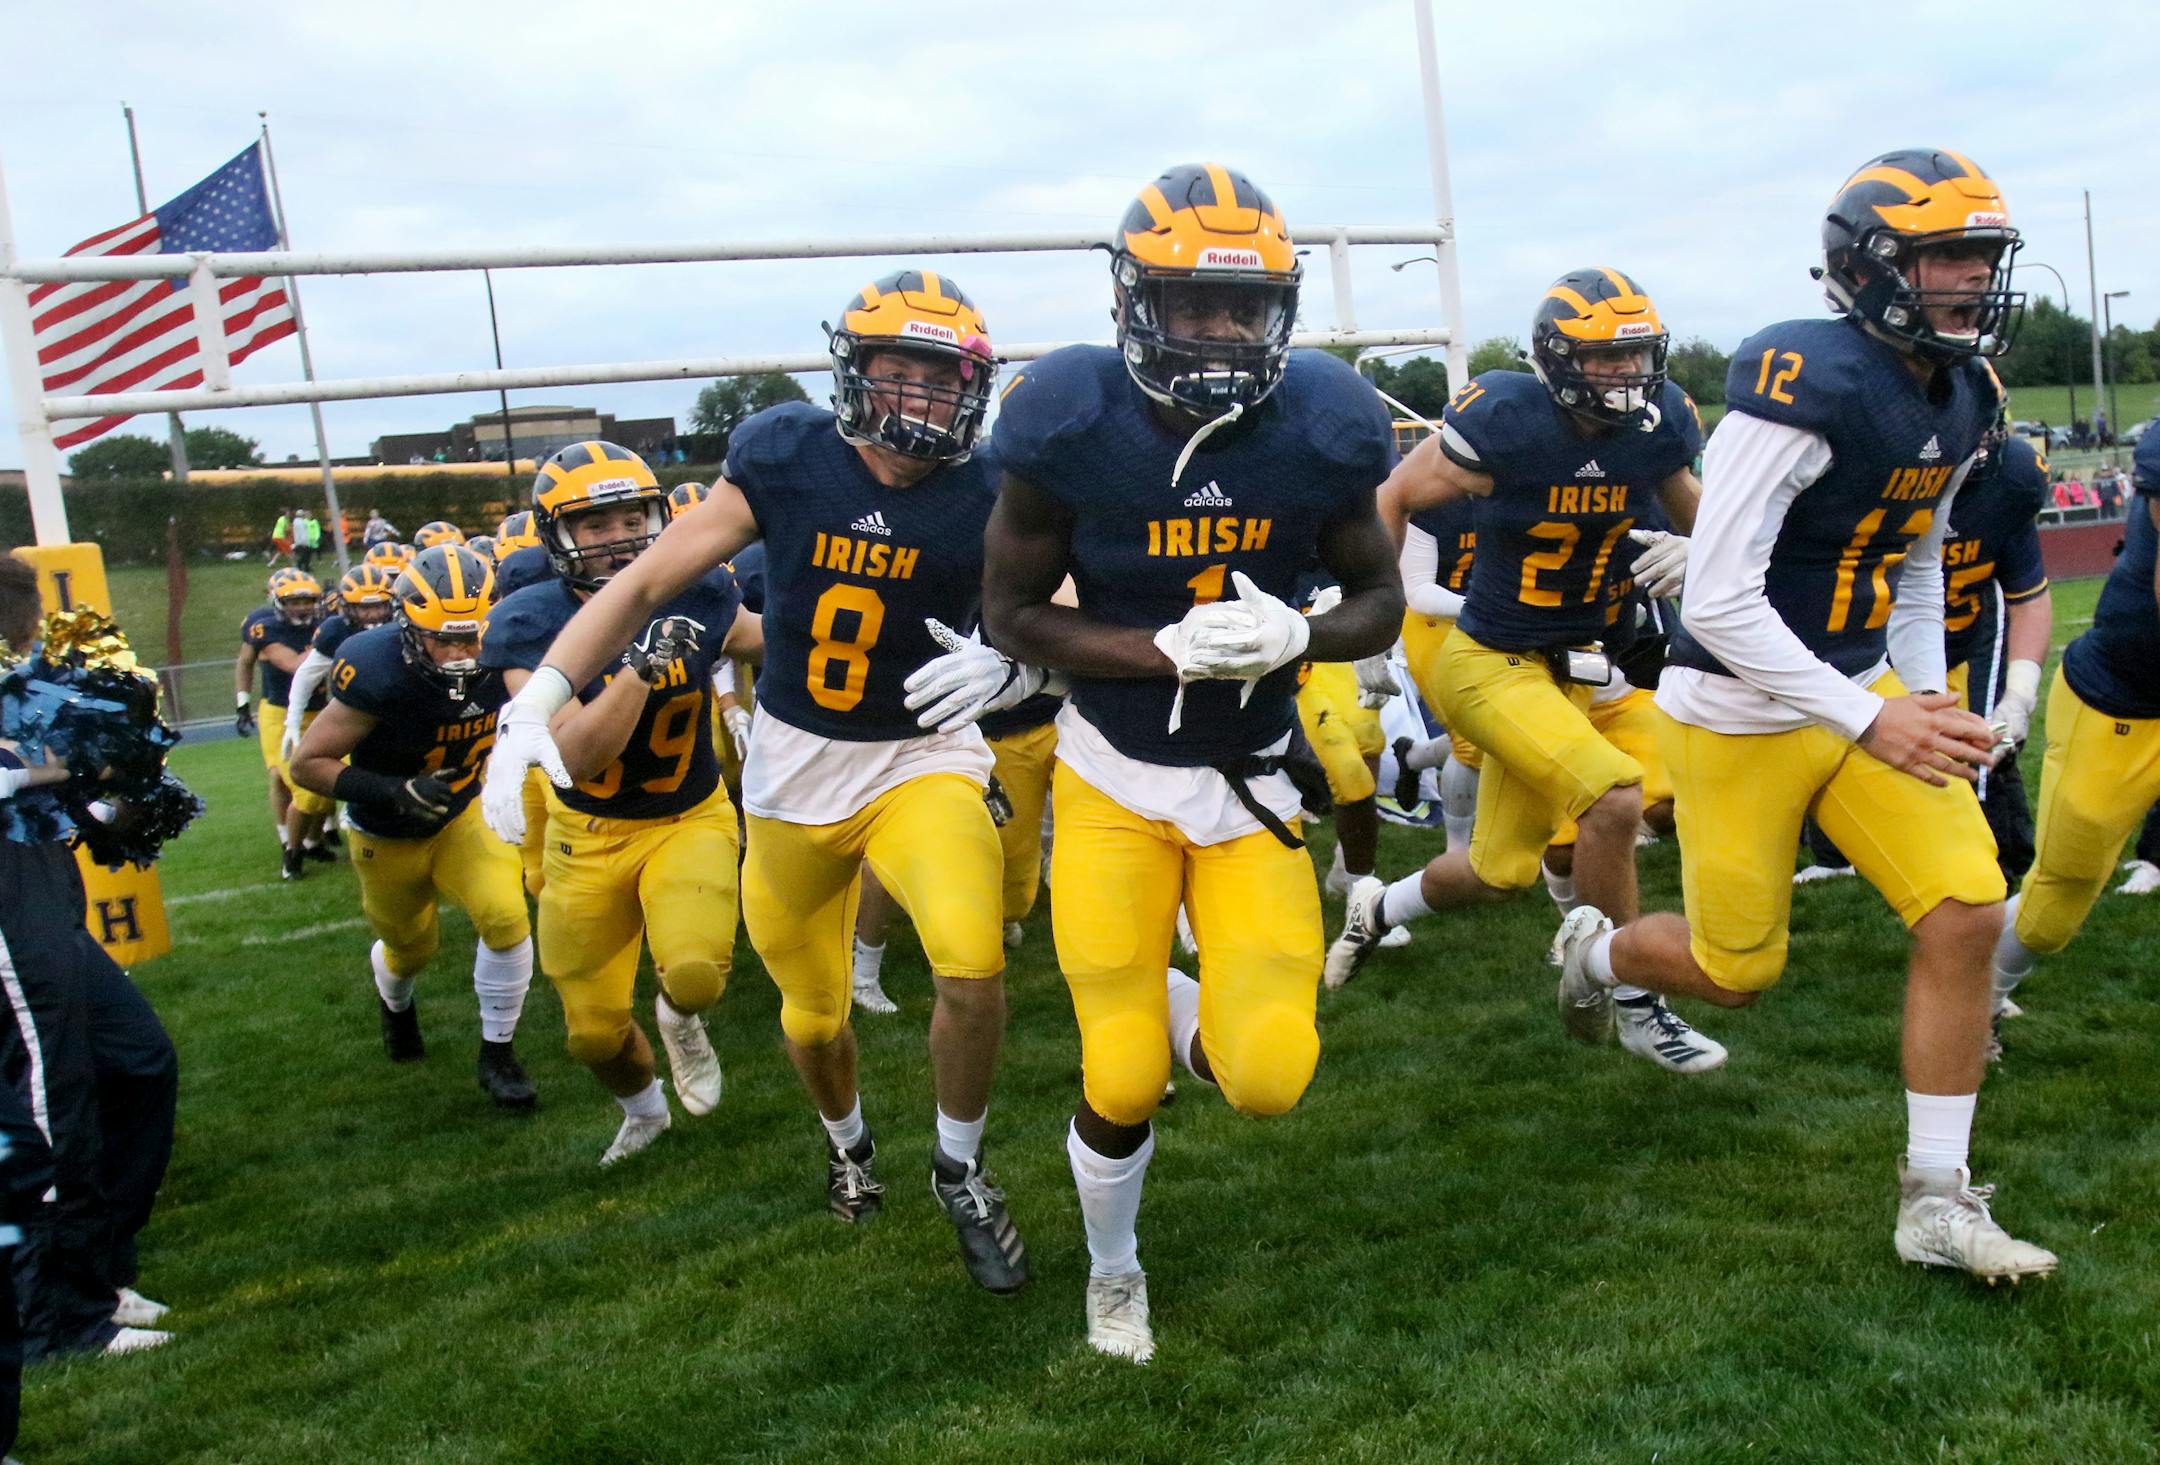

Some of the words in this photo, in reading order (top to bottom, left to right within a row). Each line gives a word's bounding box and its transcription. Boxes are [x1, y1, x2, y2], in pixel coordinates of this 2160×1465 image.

[1207, 252, 1257, 266] Riddell
[910, 323, 954, 340] Riddell
[1621, 326, 1650, 336] Riddell
[1754, 347, 1805, 405] 12
[1450, 382, 1486, 413] 21
[598, 481, 626, 491] Riddell
[1575, 470, 1606, 478] adidas
[1881, 465, 1954, 501] IRISH
[1184, 496, 1233, 507] adidas
[1548, 485, 1629, 514] IRISH
[851, 522, 892, 537] adidas
[1147, 516, 1273, 557] IRISH
[812, 531, 920, 580] IRISH
[1518, 516, 1636, 607] 21
[807, 582, 886, 712] 8
[332, 657, 357, 690] 19
[437, 711, 497, 743] IRISH
[97, 896, 142, 945] H
